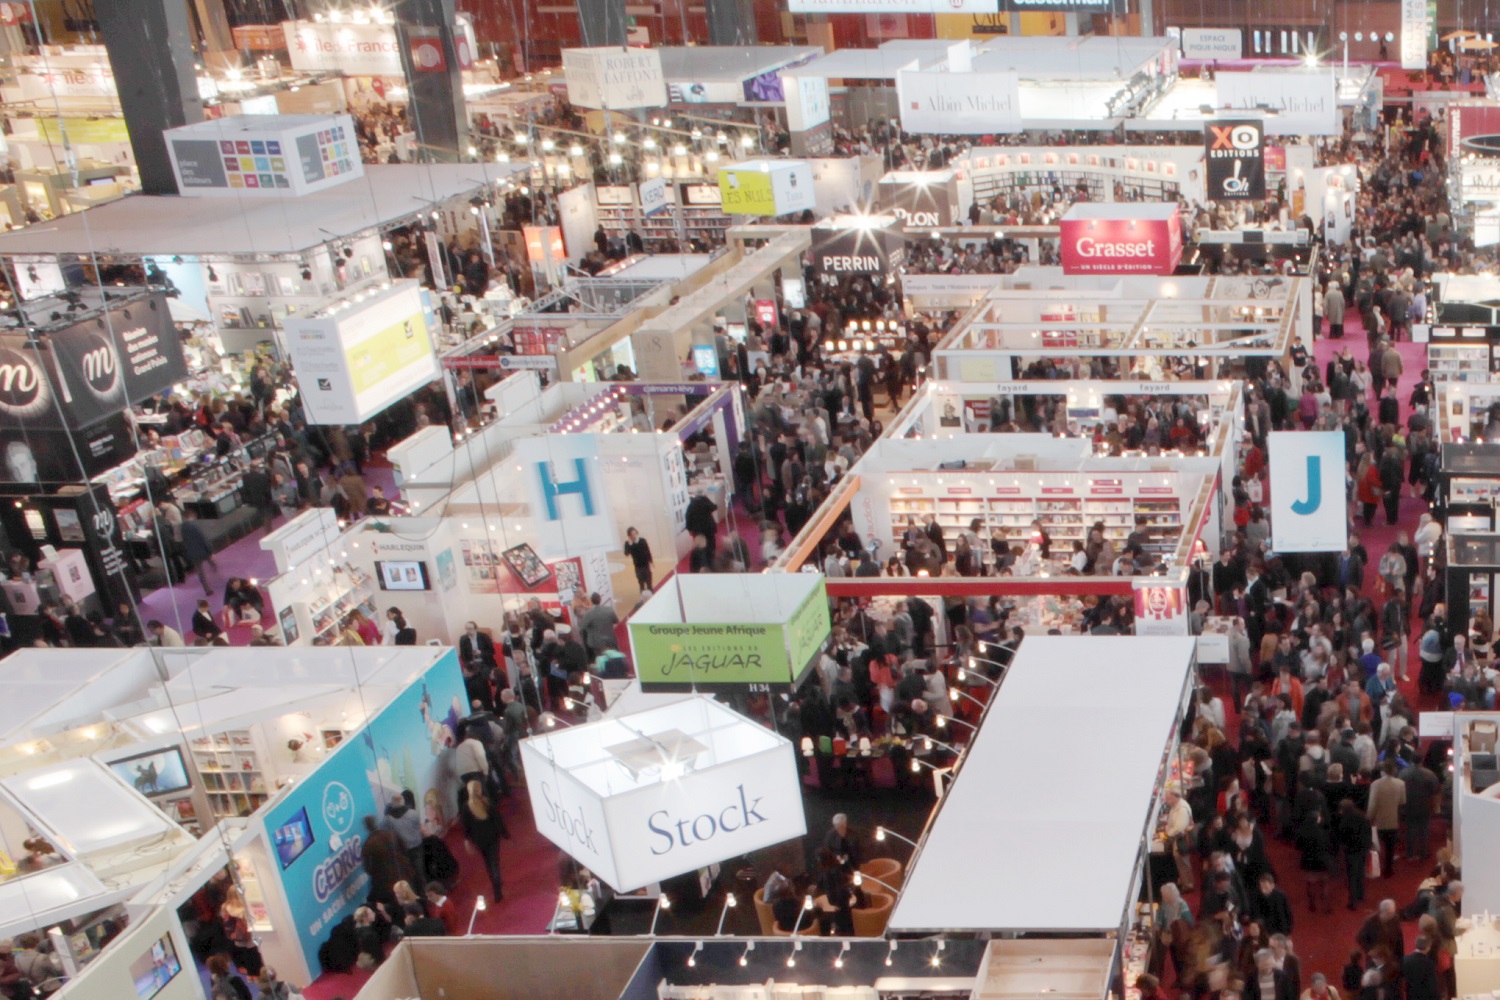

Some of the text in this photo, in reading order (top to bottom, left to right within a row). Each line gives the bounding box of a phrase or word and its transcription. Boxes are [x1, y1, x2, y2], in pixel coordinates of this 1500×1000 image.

[606, 55, 652, 70] ROBERT
[606, 70, 659, 83] LAFFONT
[926, 94, 1012, 113] Albin Michel
[1279, 97, 1324, 113] Michel
[1209, 125, 1260, 149] XO
[1210, 149, 1259, 158] EDITIONS
[723, 191, 742, 203] LES
[893, 208, 939, 226] PLON
[1076, 238, 1155, 258] Grasset
[824, 256, 879, 272] PERRIN
[997, 384, 1028, 392] fayard
[1139, 383, 1170, 392] fayard
[537, 457, 598, 521] H
[1290, 455, 1320, 515] J
[380, 544, 425, 552] HARLEQUIN
[649, 624, 766, 637] Groupe Jeune Afrique
[661, 652, 762, 676] JAGUAR
[750, 684, 770, 693] H 34
[541, 779, 599, 856] Stock
[648, 784, 769, 856] Stock
